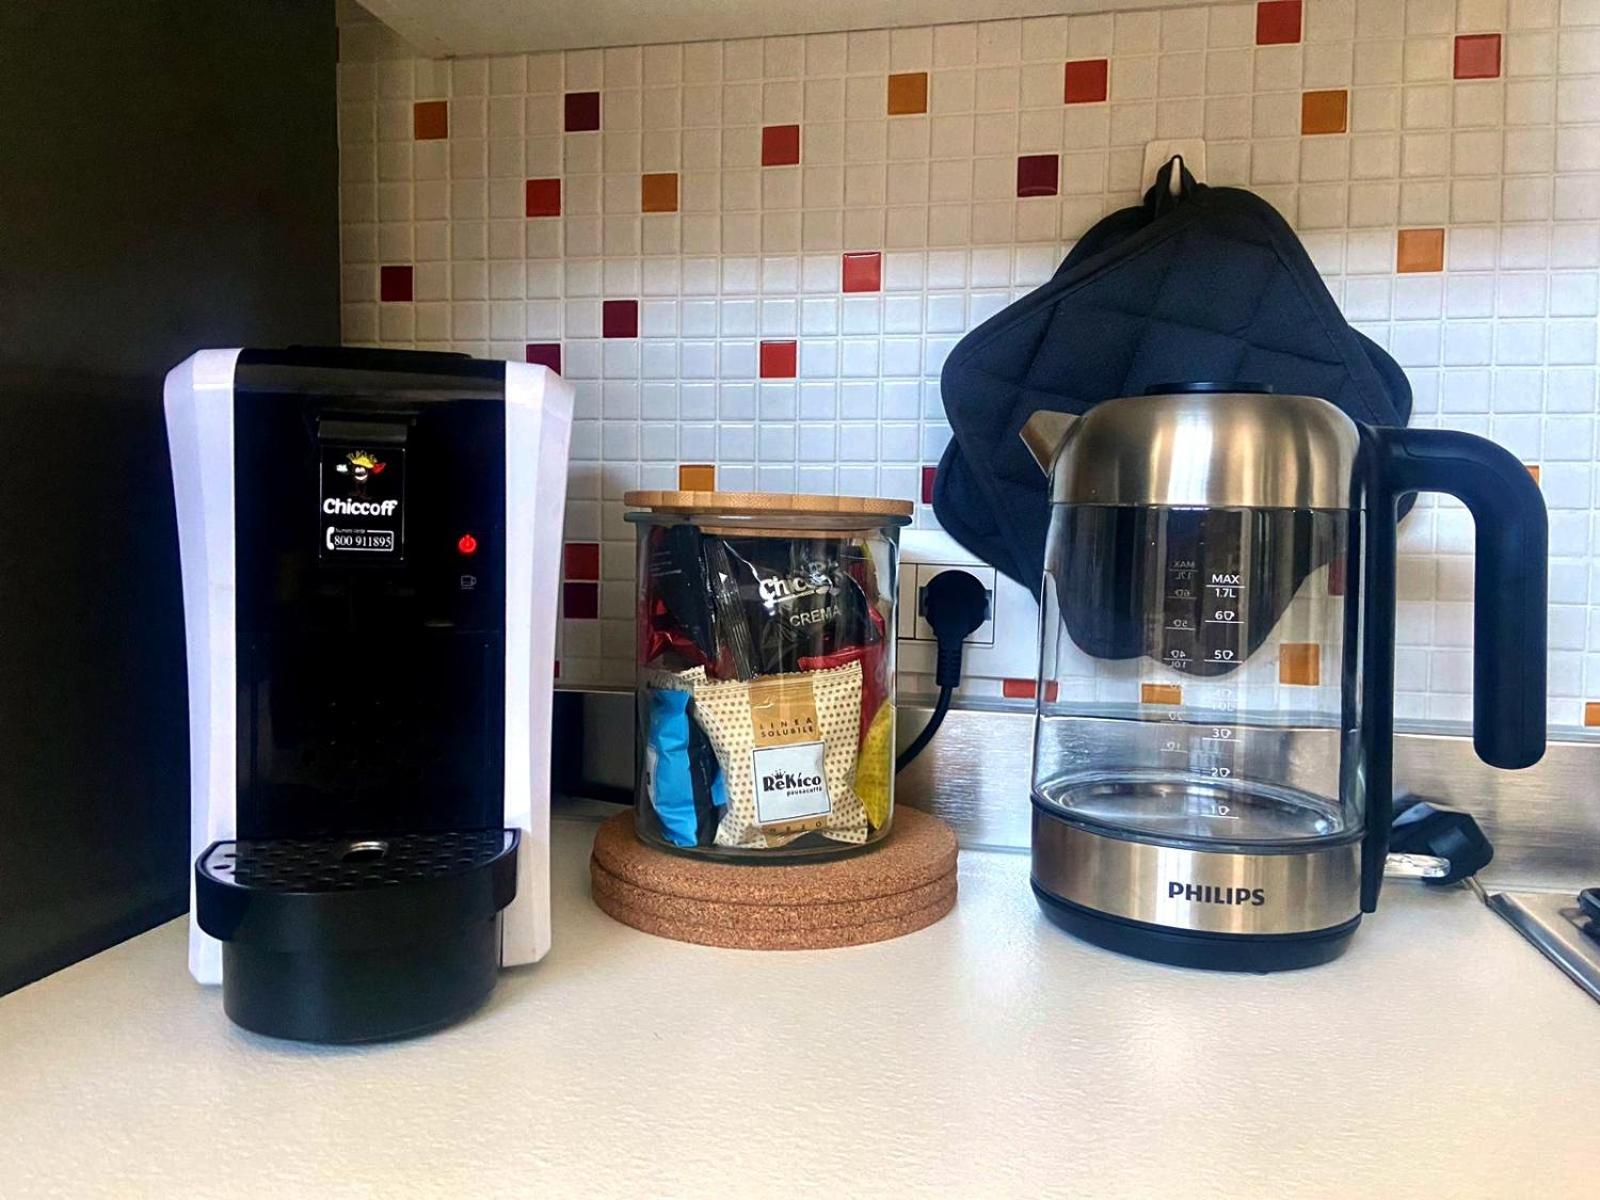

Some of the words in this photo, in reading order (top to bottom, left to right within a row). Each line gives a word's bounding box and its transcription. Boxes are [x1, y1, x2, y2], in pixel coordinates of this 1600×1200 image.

[323, 498, 398, 516] Chiccoff
[334, 535, 353, 546] 800
[355, 536, 391, 548] 911895
[1212, 574, 1240, 584] MAX
[1215, 588, 1236, 598] 1.7L
[789, 604, 842, 627] CREMA
[760, 717, 812, 730] LINEA
[761, 725, 814, 738] SOLUBILE
[1168, 881, 1265, 906] PHILIPS
